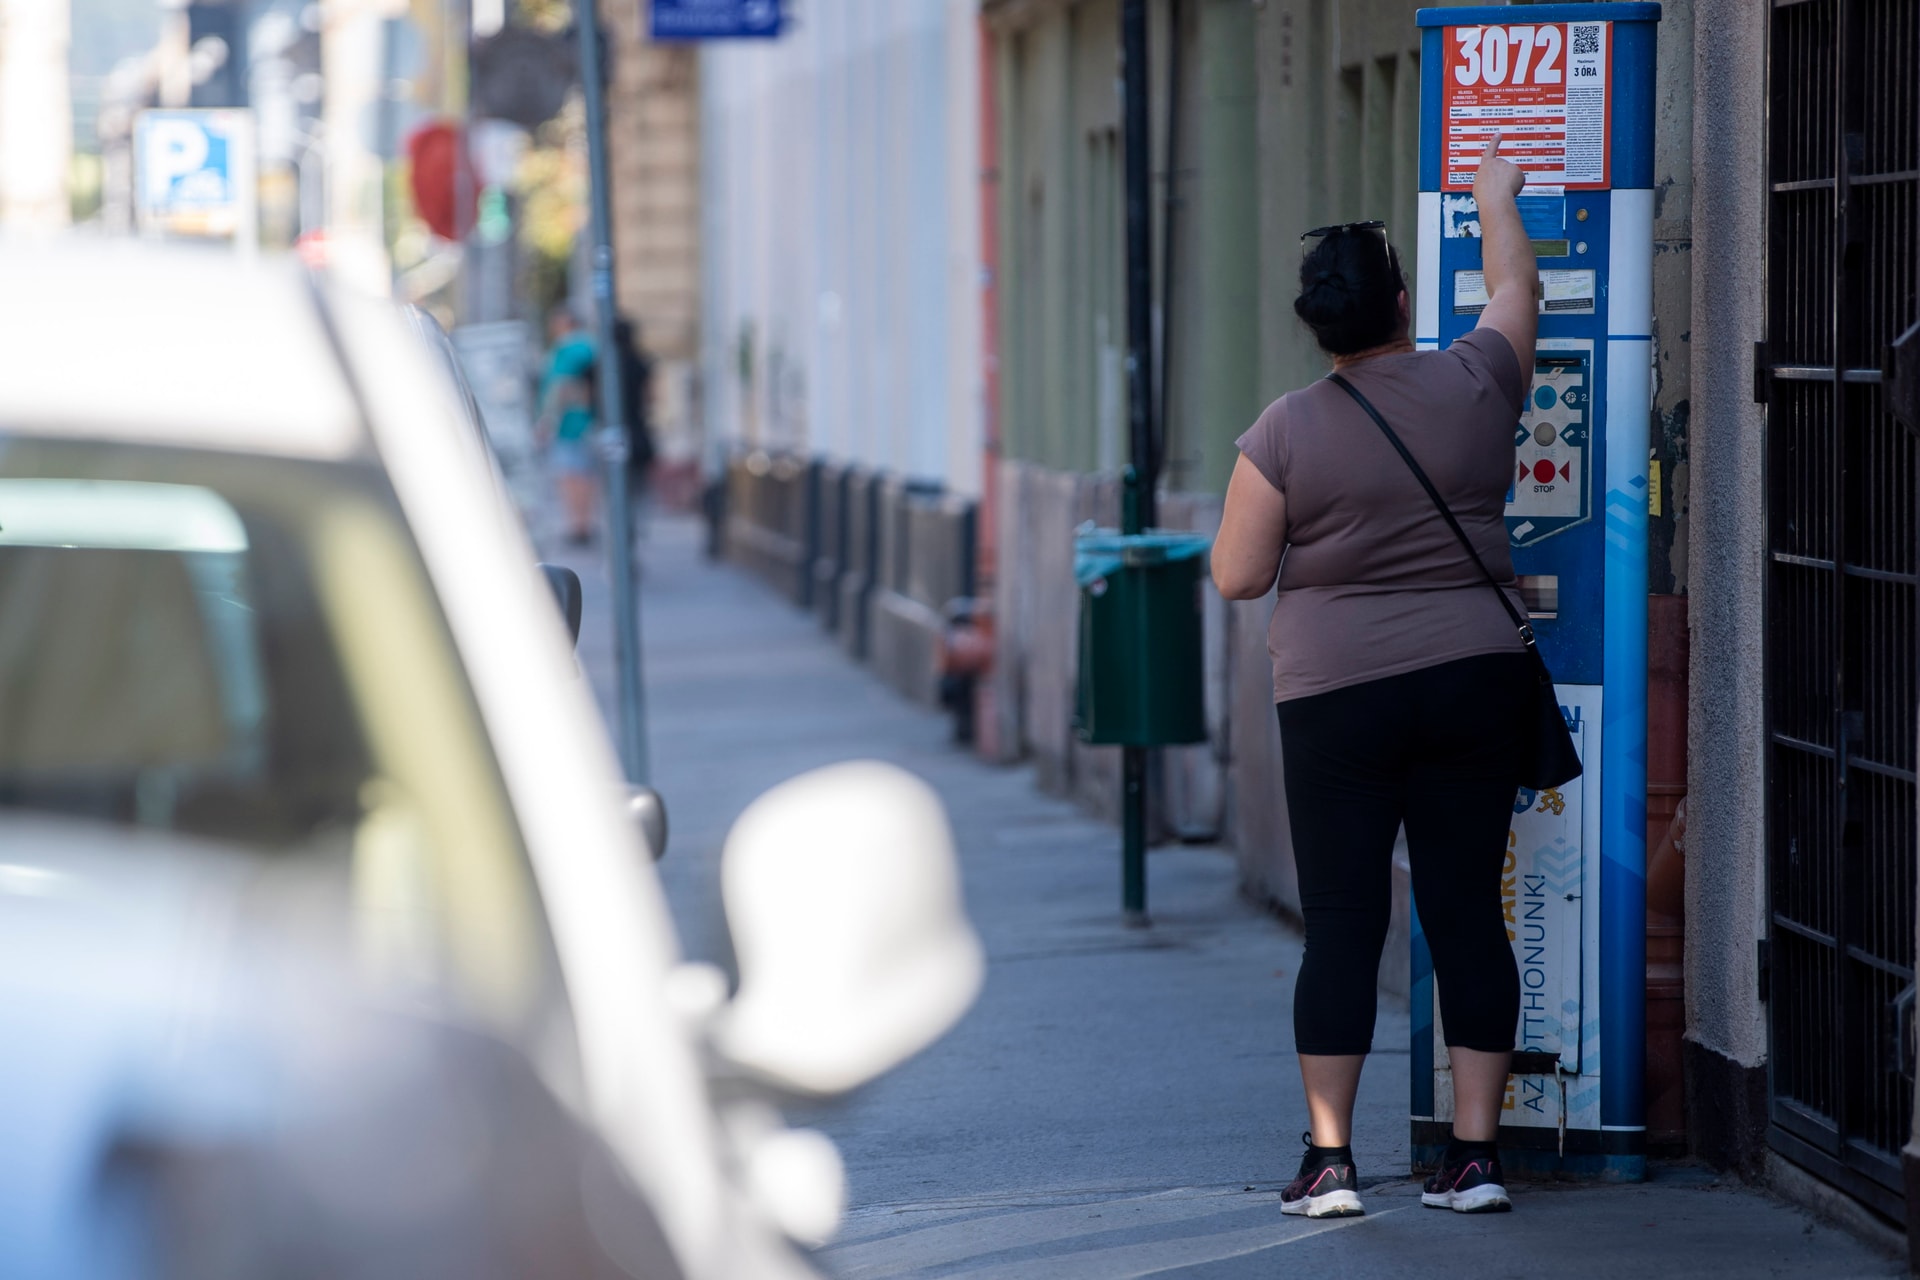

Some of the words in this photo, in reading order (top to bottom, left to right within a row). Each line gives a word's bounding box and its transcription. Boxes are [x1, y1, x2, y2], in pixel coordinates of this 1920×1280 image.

[1454, 24, 1562, 86] 3072
[1574, 67, 1579, 77] 3
[1581, 64, 1597, 77] ÓRA
[1533, 485, 1555, 493] STOP
[1523, 1079, 1545, 1113] AZ
